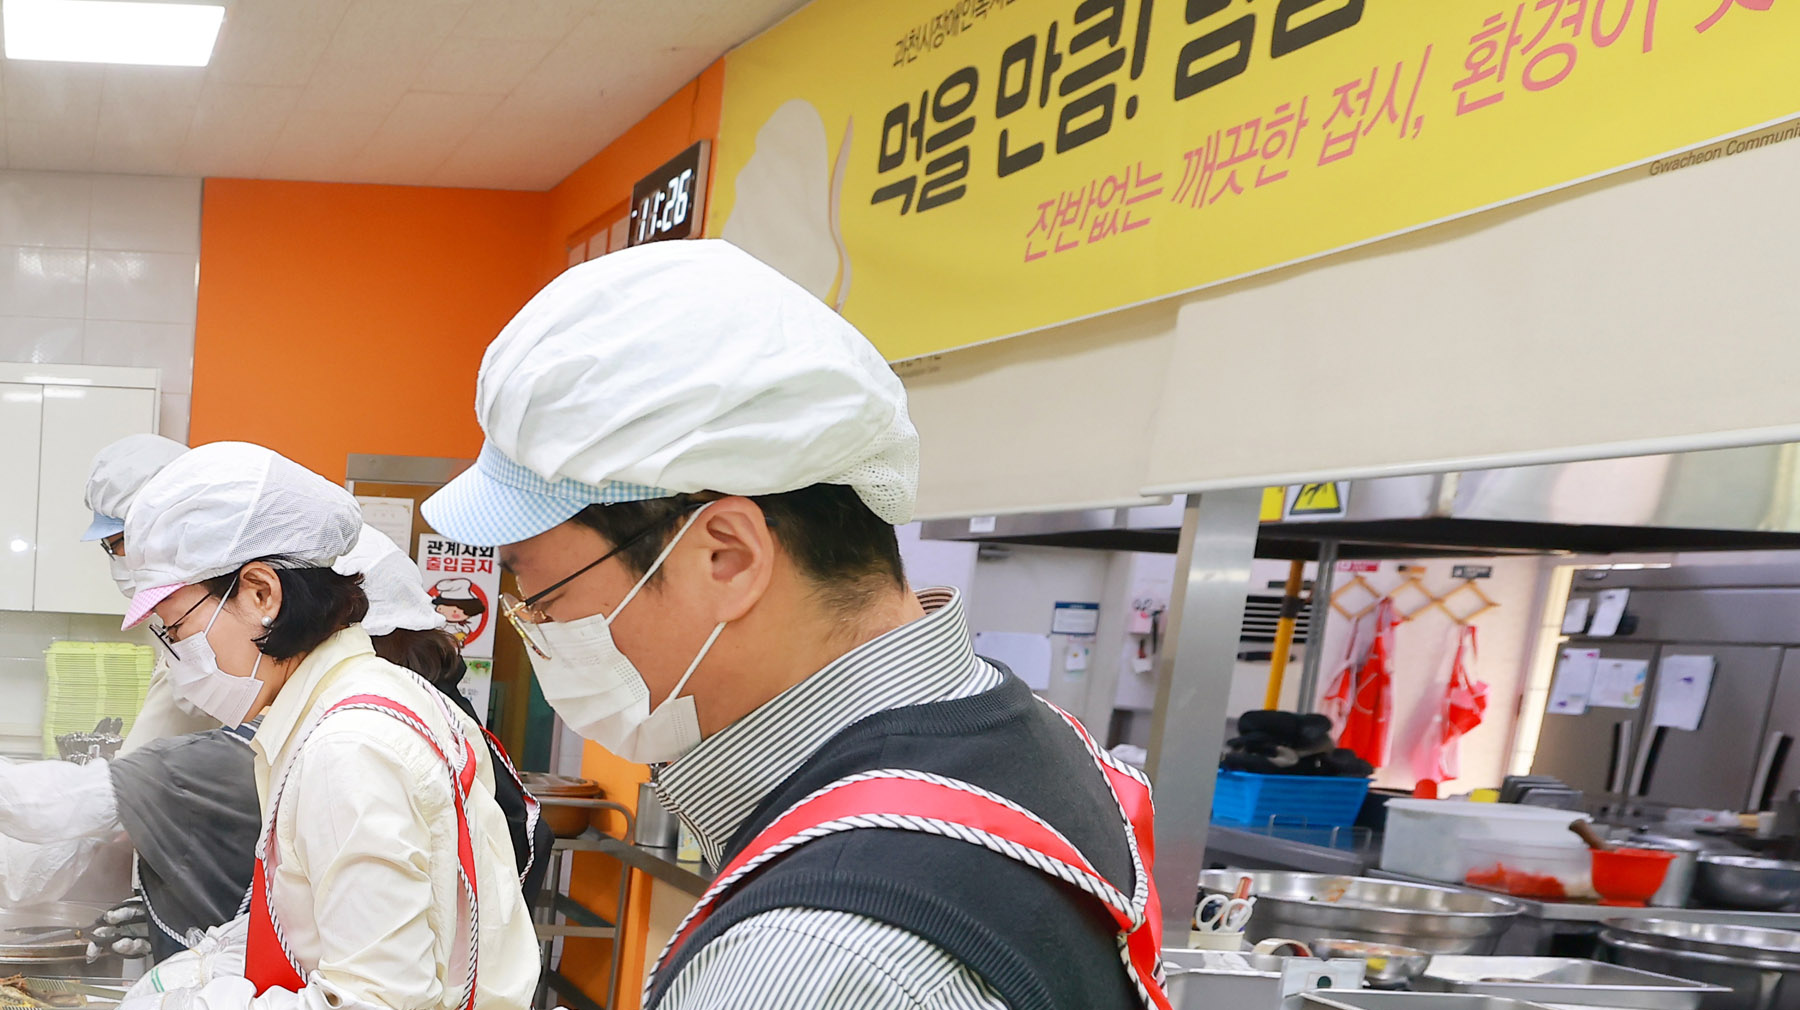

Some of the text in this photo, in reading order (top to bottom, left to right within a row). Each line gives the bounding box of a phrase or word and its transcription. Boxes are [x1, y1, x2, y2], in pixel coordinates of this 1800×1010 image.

[892, 0, 1016, 67] 과천시장애인복
[871, 65, 979, 215] 먹을
[995, 0, 1153, 178] 만큼!
[1024, 161, 1163, 263] 잔반없는
[1171, 95, 1309, 208] 깨끗한
[1317, 44, 1433, 166] 접시,
[1649, 121, 1800, 176] Gwacheon Communi
[638, 168, 693, 242] 11:26
[426, 556, 493, 574] 출입금지
